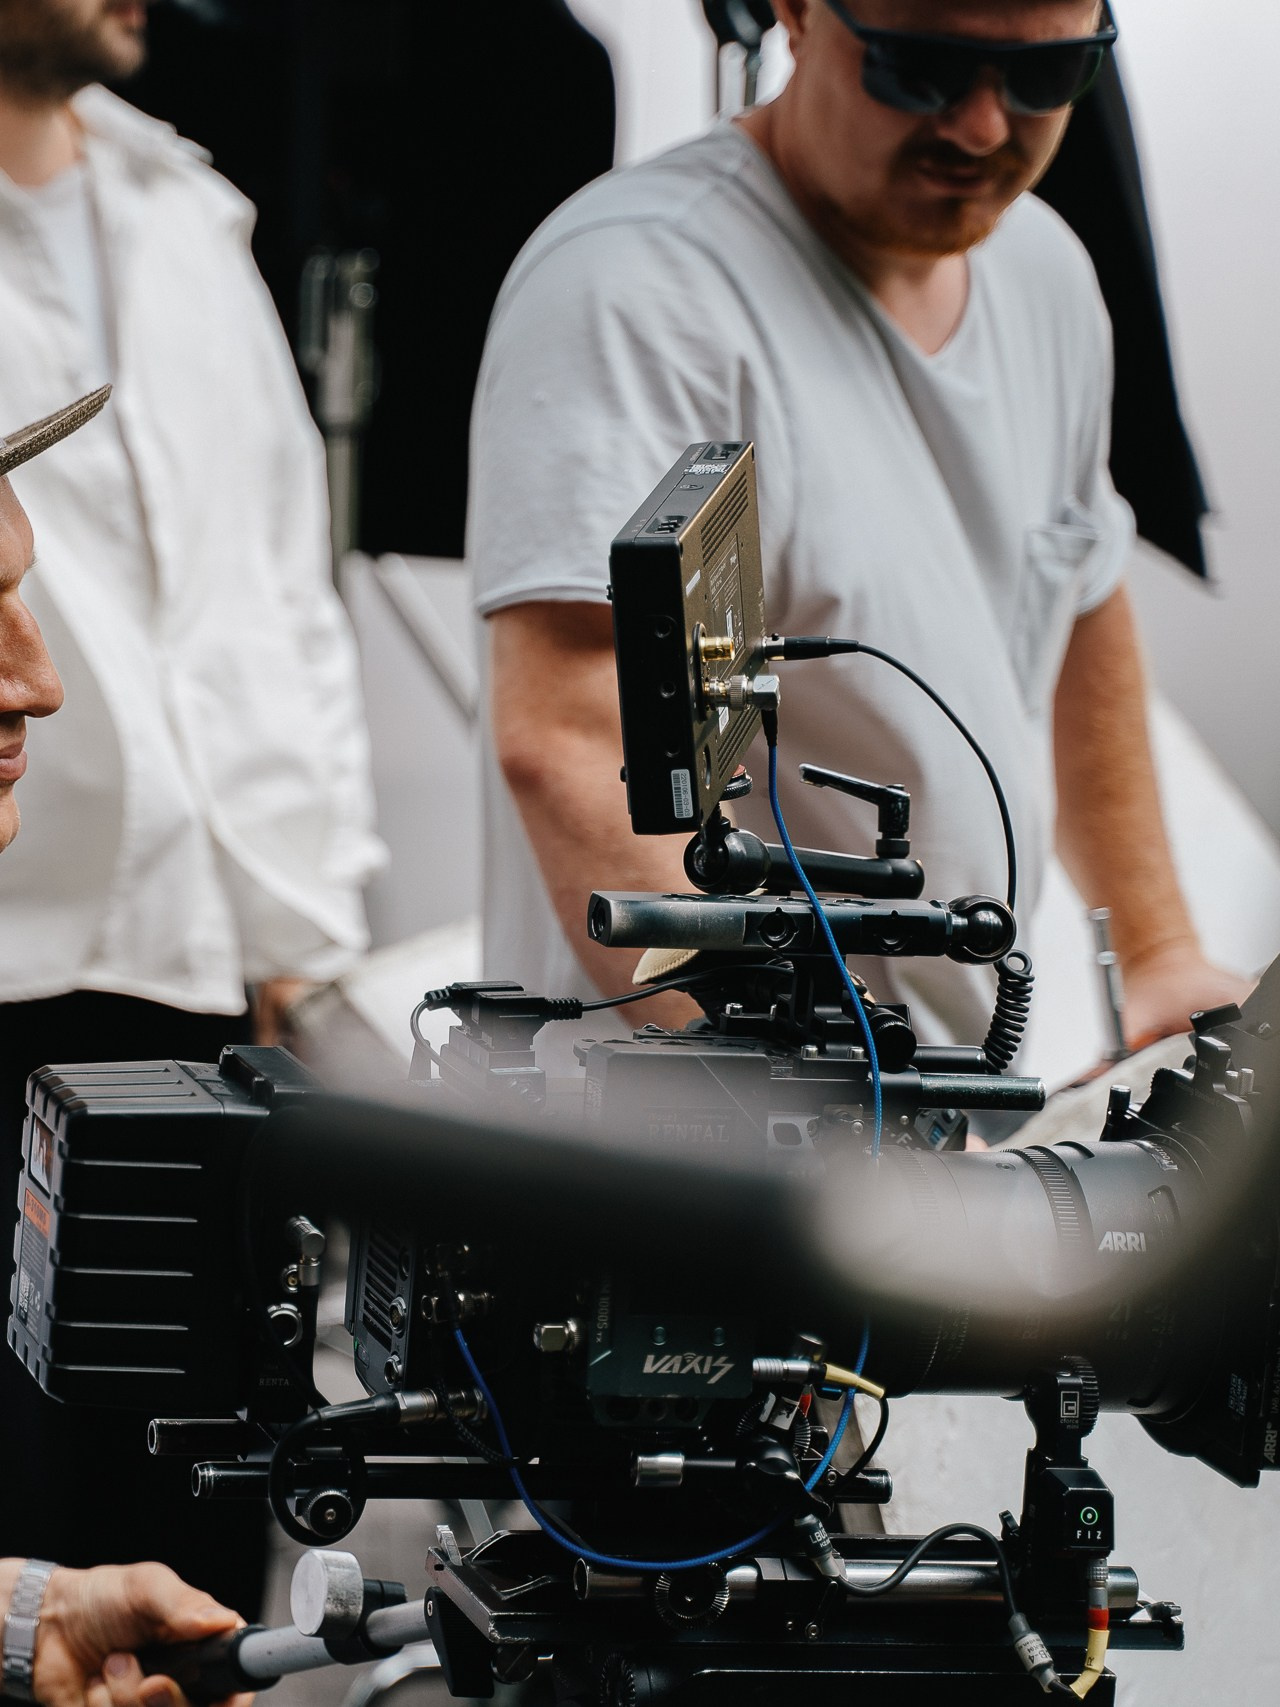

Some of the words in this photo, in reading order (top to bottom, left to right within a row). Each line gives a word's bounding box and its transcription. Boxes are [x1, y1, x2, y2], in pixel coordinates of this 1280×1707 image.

[1098, 1231, 1147, 1252] ARRI
[642, 1352, 736, 1384] VAXIS
[1263, 1428, 1278, 1464] ARRI
